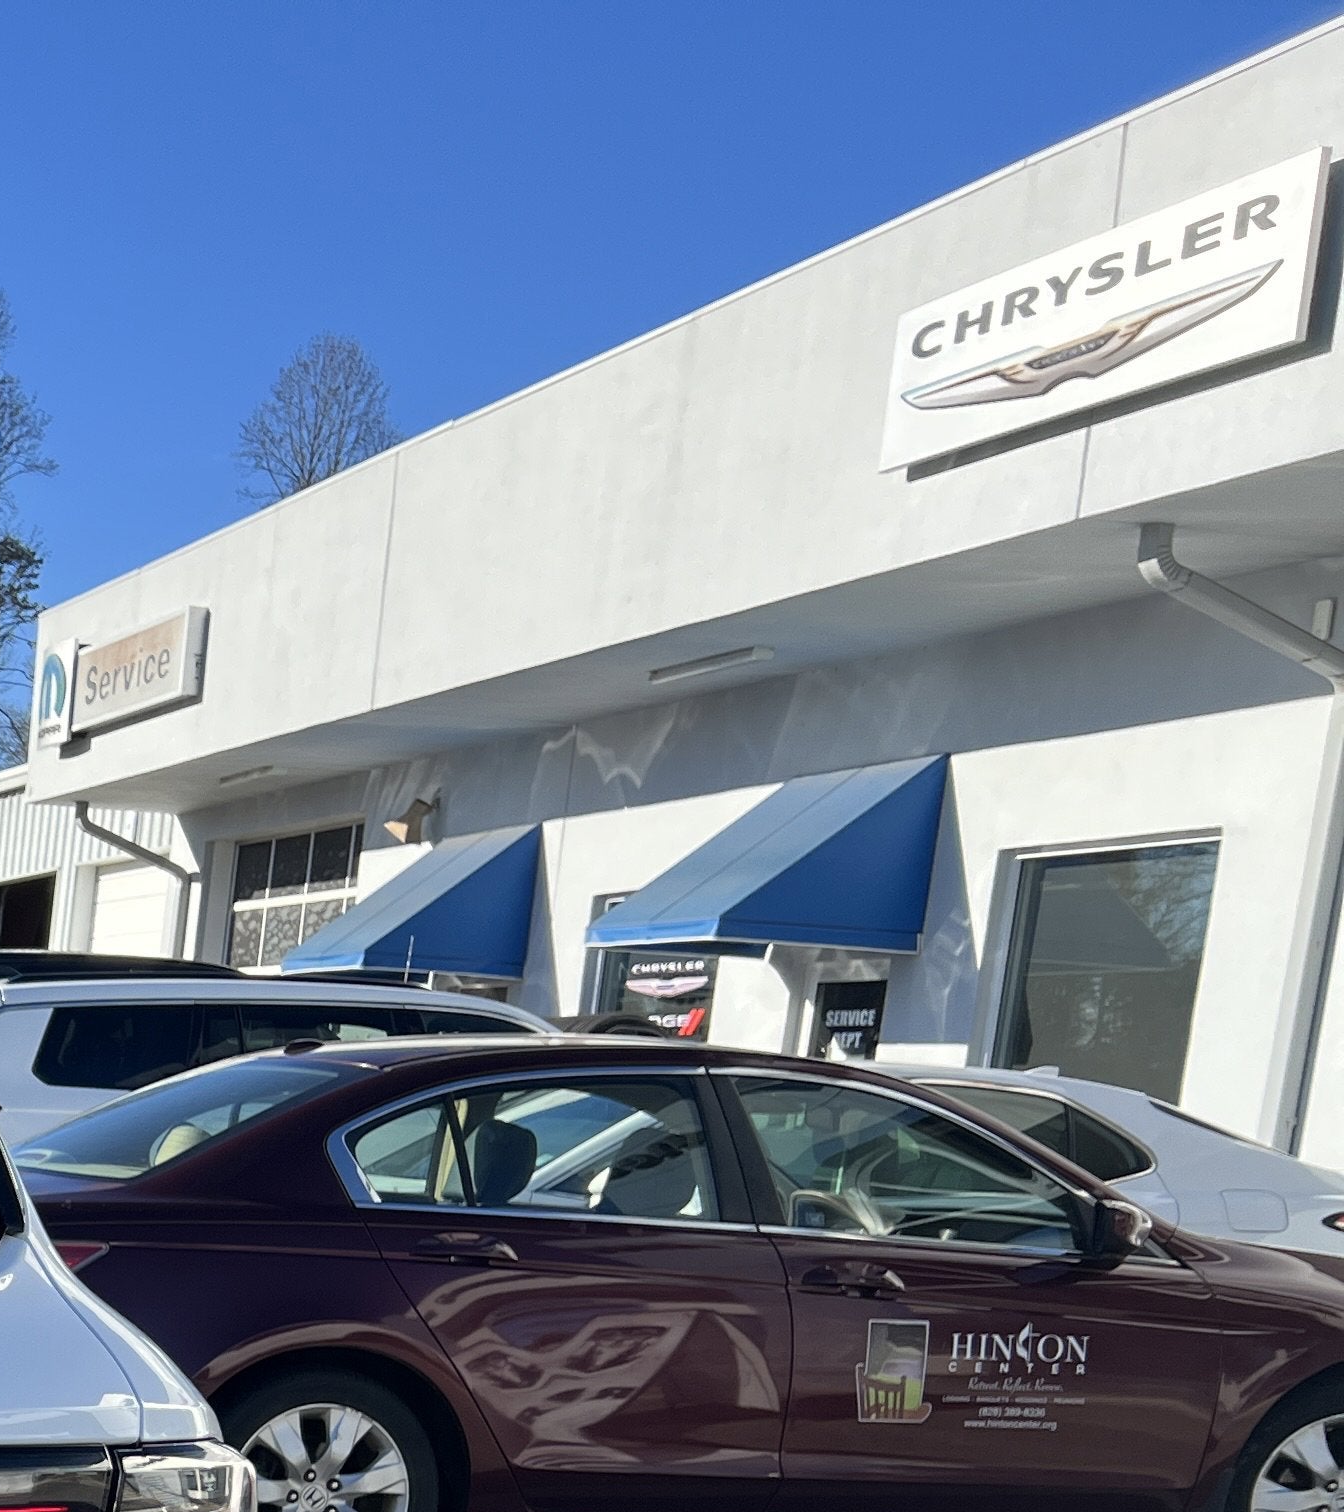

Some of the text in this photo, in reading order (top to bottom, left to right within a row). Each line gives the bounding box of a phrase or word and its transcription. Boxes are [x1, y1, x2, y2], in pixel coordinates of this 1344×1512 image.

[911, 193, 1281, 360] CHRYSLER
[85, 646, 171, 706] Service
[631, 960, 705, 975] CHRYSLER
[825, 1008, 876, 1028] SERVICE
[951, 1323, 1090, 1363] HINTON
[948, 1361, 1086, 1375] CENTER
